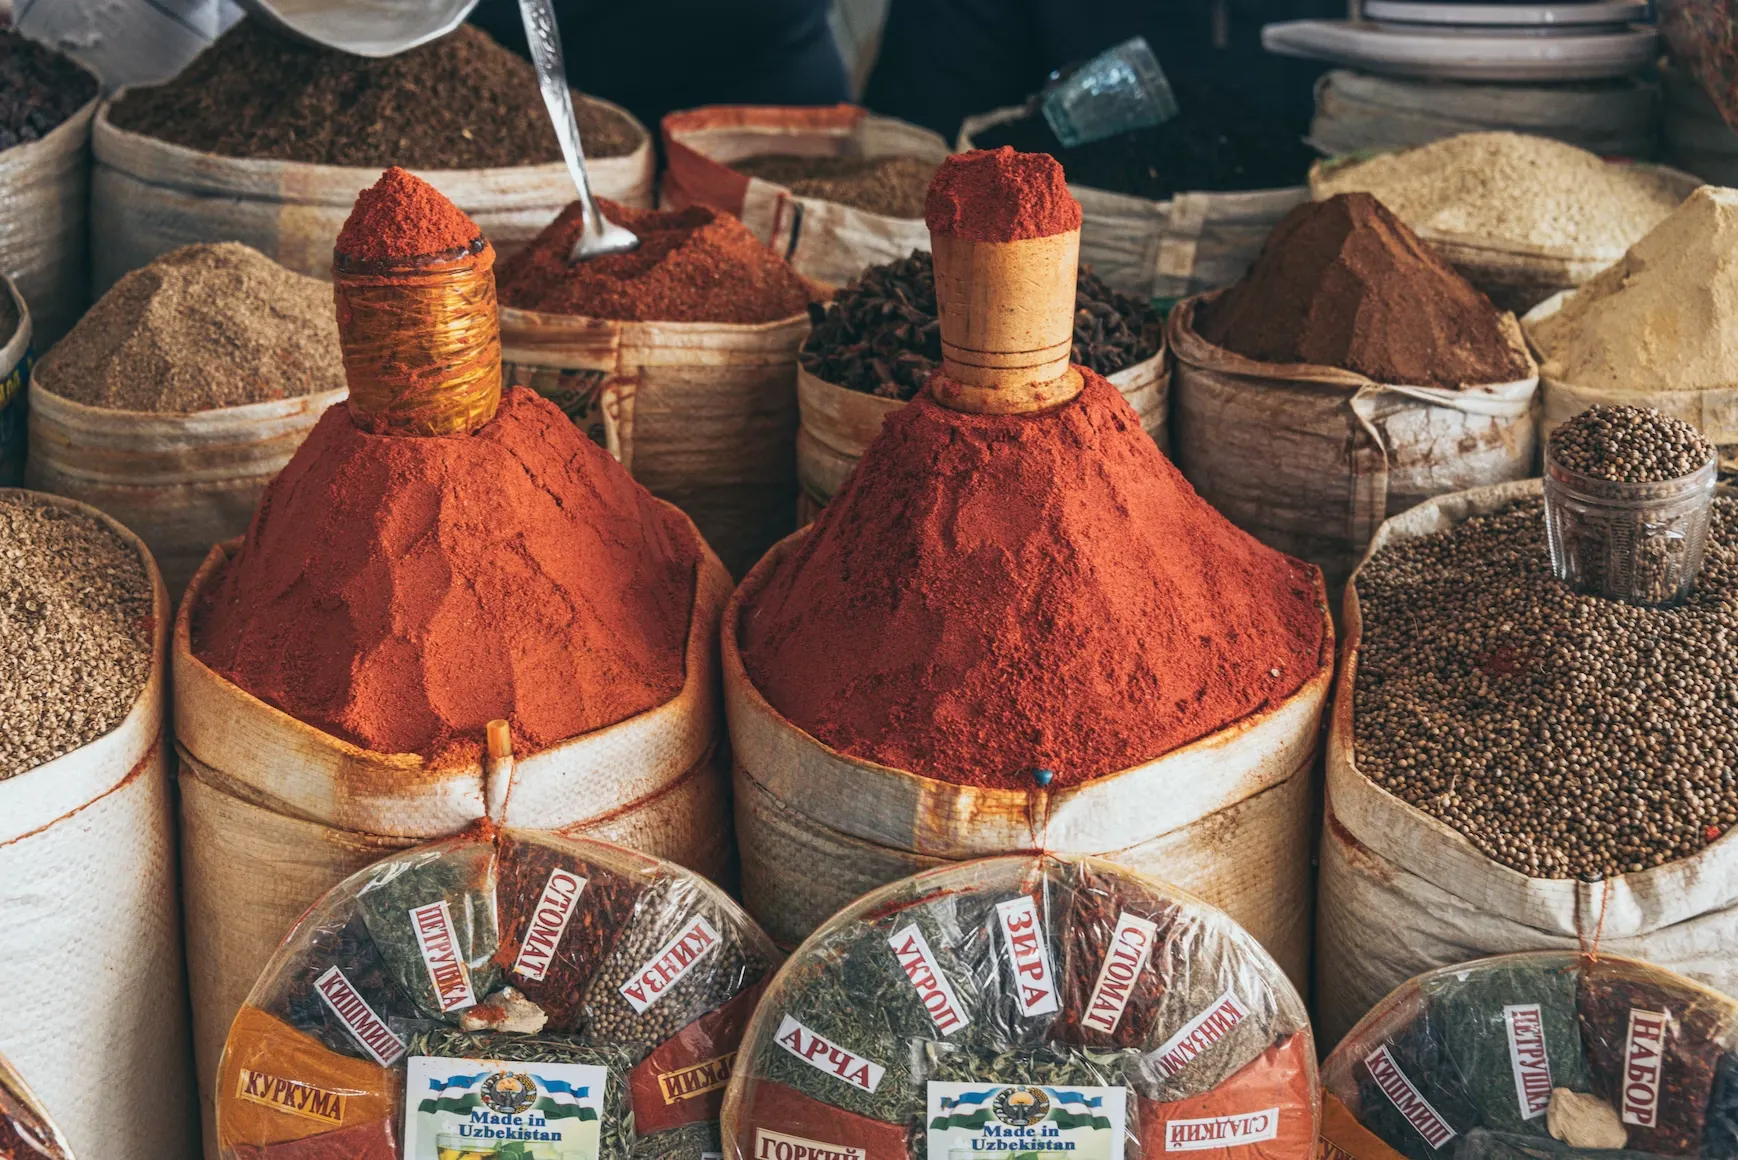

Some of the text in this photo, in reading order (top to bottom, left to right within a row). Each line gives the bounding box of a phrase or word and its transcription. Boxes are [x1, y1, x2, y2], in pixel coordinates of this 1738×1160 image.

[415, 904, 469, 1010] ПЕТРУШКА
[518, 874, 577, 978] С/ТОМАТ
[623, 922, 715, 1004] КИНЗА
[1006, 910, 1050, 1009] ЗИРА
[318, 970, 402, 1063] КИШМИШ
[892, 934, 961, 1031] УКРОП
[1088, 926, 1147, 1032] С/ТОМАТ
[243, 1070, 341, 1121] КУРКУМА
[780, 1026, 871, 1090] АРЧА
[1366, 1048, 1453, 1148] КИШМИШ
[1511, 1008, 1553, 1114] ПЕТРУШКА
[1624, 1015, 1663, 1125] НАБОР
[458, 1123, 563, 1142] Uzbekistan
[469, 1110, 547, 1128] Made in
[970, 1138, 1077, 1152] Uzbekistan
[982, 1124, 1060, 1138] Made in
[1169, 1114, 1269, 1148] СЛАДКИЙ
